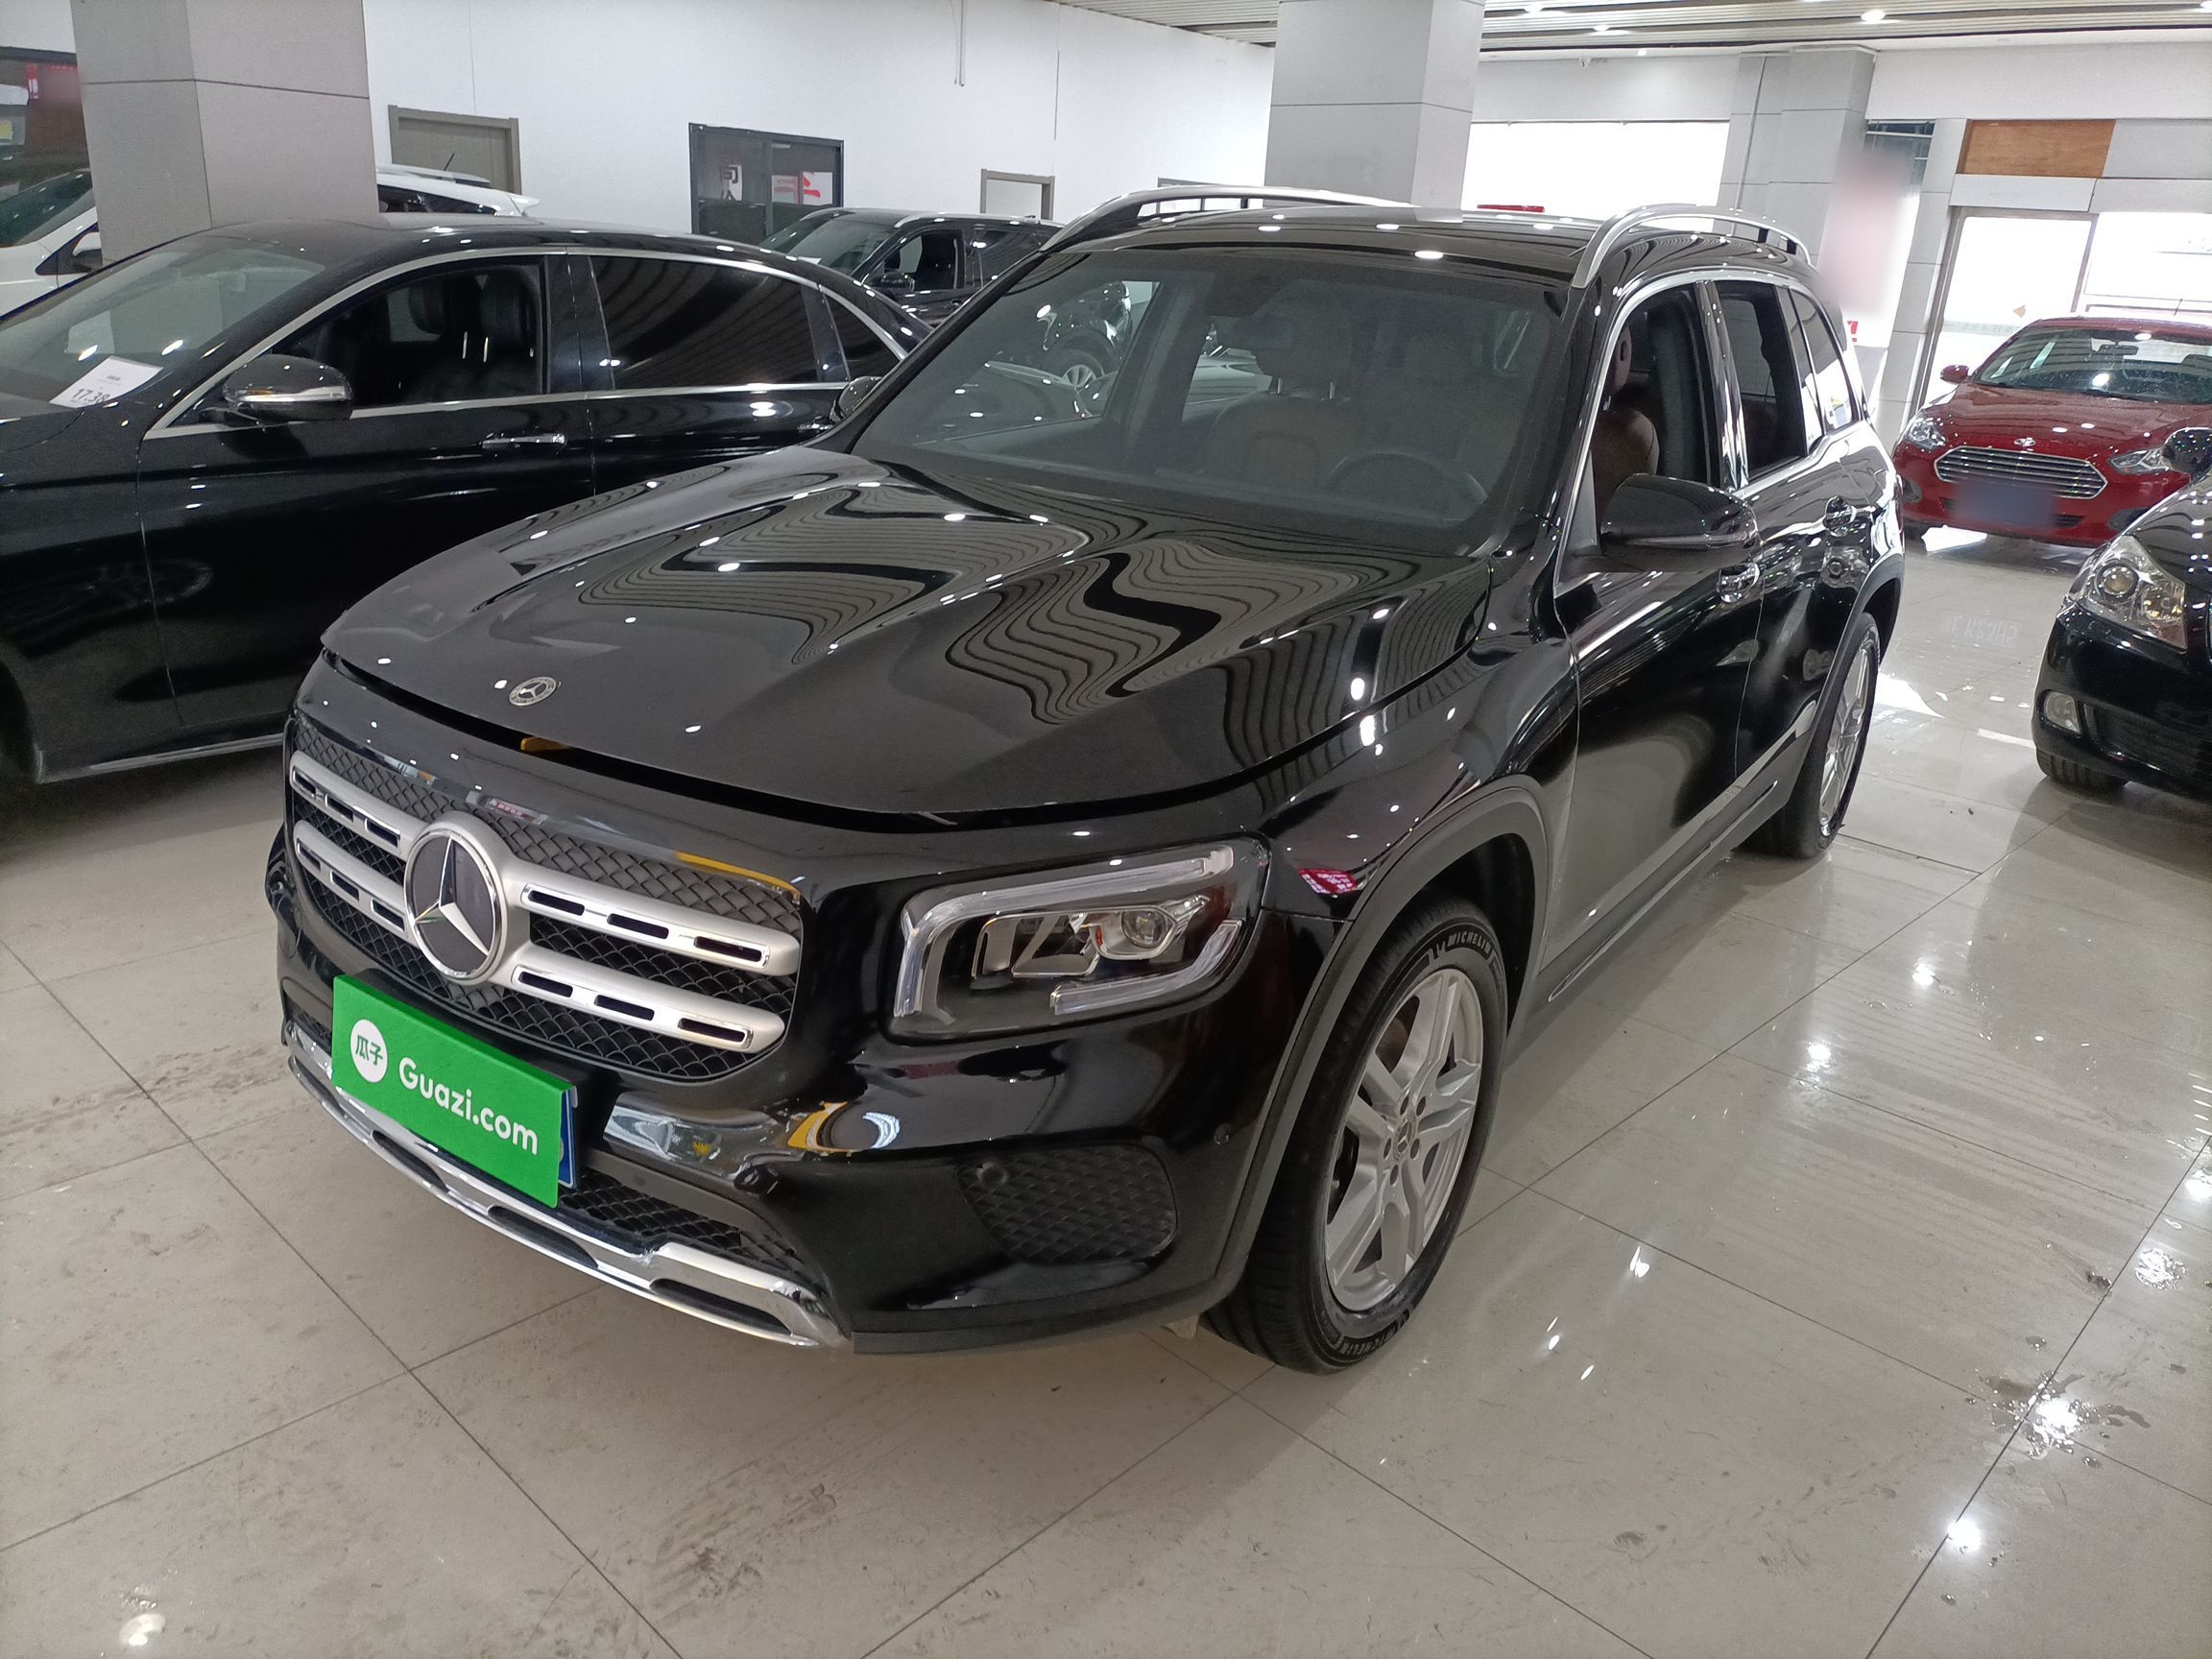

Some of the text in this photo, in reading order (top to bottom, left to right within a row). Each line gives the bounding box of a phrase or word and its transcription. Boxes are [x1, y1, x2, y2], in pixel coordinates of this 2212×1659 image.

[1447, 930, 1492, 954] MICHELIN
[355, 1034, 384, 1067] 瓜子
[398, 1057, 538, 1155] Guazi.com
